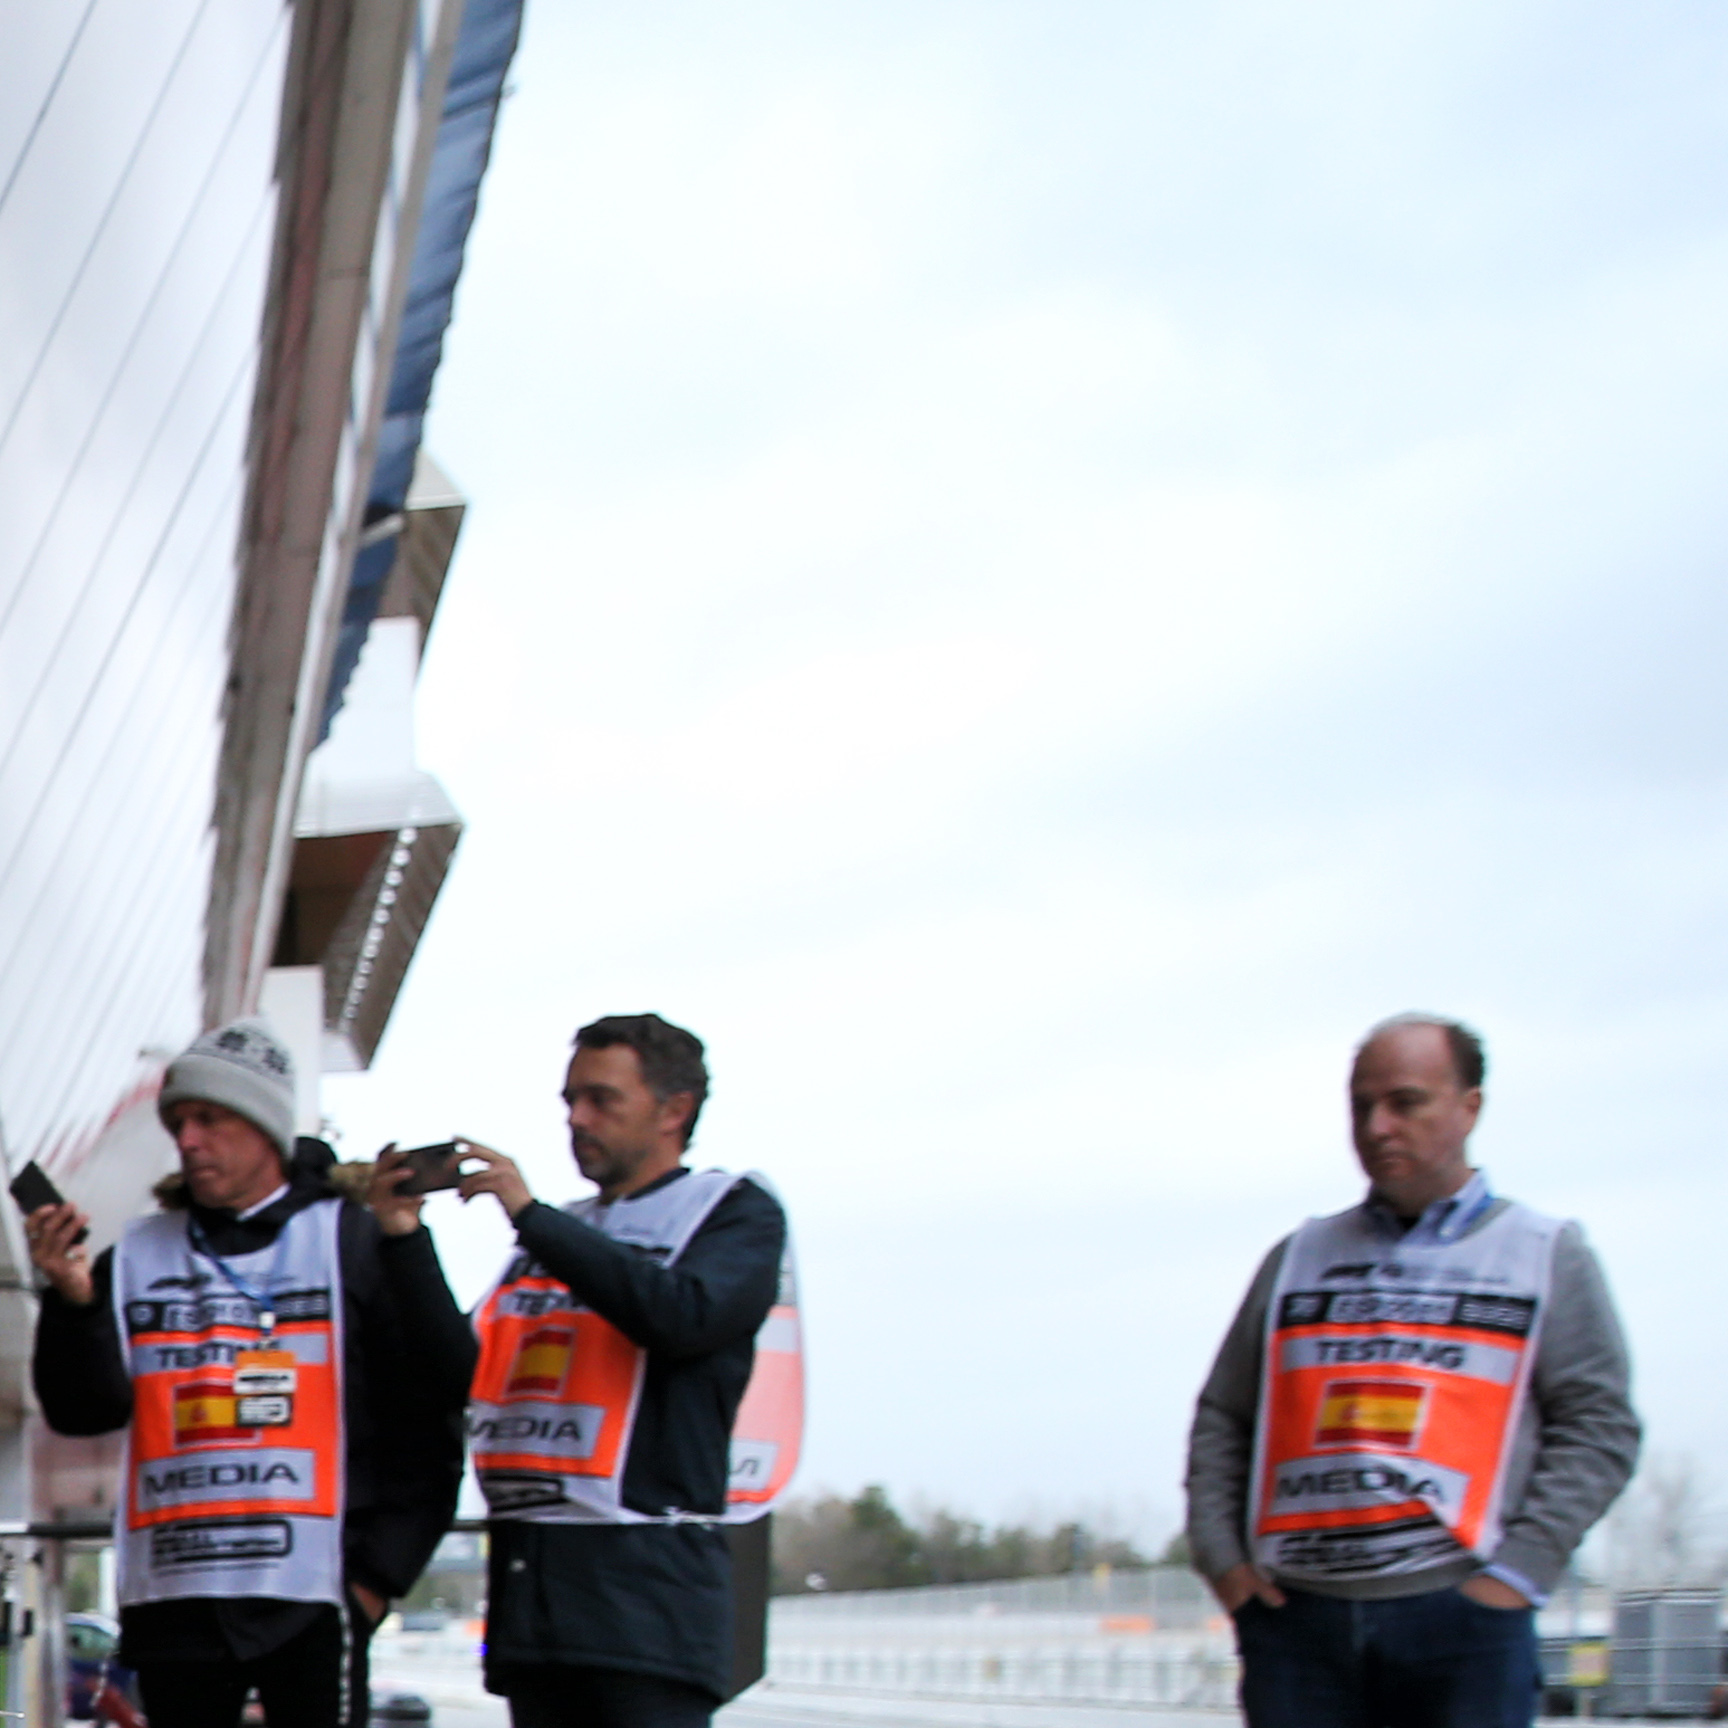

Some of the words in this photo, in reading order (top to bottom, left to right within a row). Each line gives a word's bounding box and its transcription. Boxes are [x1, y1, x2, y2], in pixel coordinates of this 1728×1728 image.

[155, 1338, 281, 1371] TESTI
[1317, 1339, 1465, 1369] TESTING
[144, 1461, 300, 1493] MEDIA
[1276, 1466, 1441, 1501] MEDIA
